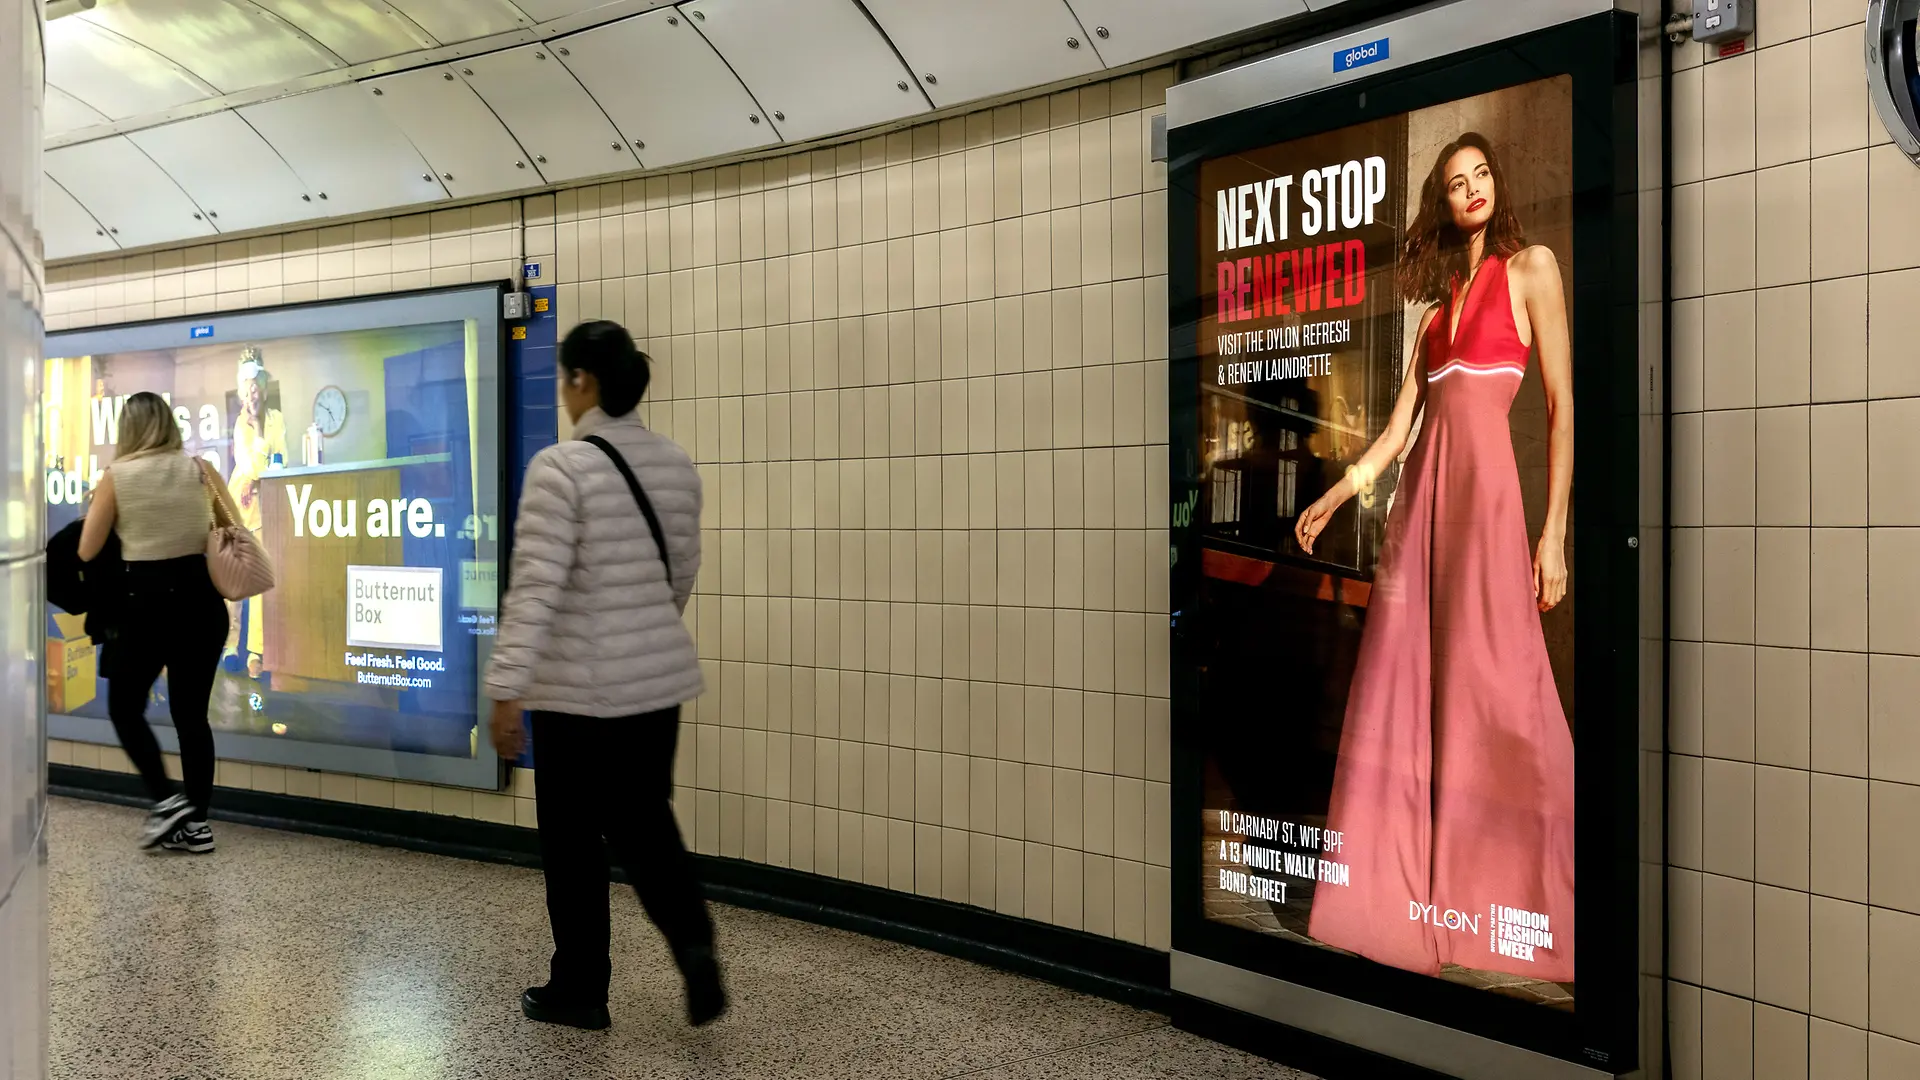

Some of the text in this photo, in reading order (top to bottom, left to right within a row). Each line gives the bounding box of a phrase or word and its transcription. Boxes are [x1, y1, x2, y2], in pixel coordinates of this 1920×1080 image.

[1346, 42, 1378, 68] global
[1217, 156, 1386, 252] NEXT STOP
[1217, 239, 1366, 324] RENEWED
[1218, 319, 1350, 356] VISIT THE DYLON REFRESH
[1218, 353, 1332, 385] & RENEW LAUNDRETTE
[199, 404, 220, 440] a
[45, 455, 83, 504] od
[286, 484, 445, 538] You are.
[355, 578, 435, 602] Butternut
[355, 603, 382, 624] Box
[345, 652, 445, 671] Feed Fresh. Feel Good.
[357, 671, 431, 688] ButternutBox.com
[1220, 810, 1344, 854] 10 CARNABY ST, W1F 9PF
[1220, 840, 1350, 887] A 13 MINUTE WALK FROM
[1220, 869, 1287, 904] BOND STREET
[1409, 900, 1478, 935] DYLON
[1498, 905, 1549, 931] LONDON
[1498, 922, 1553, 949] FASHION
[1498, 938, 1534, 962] WEEK
